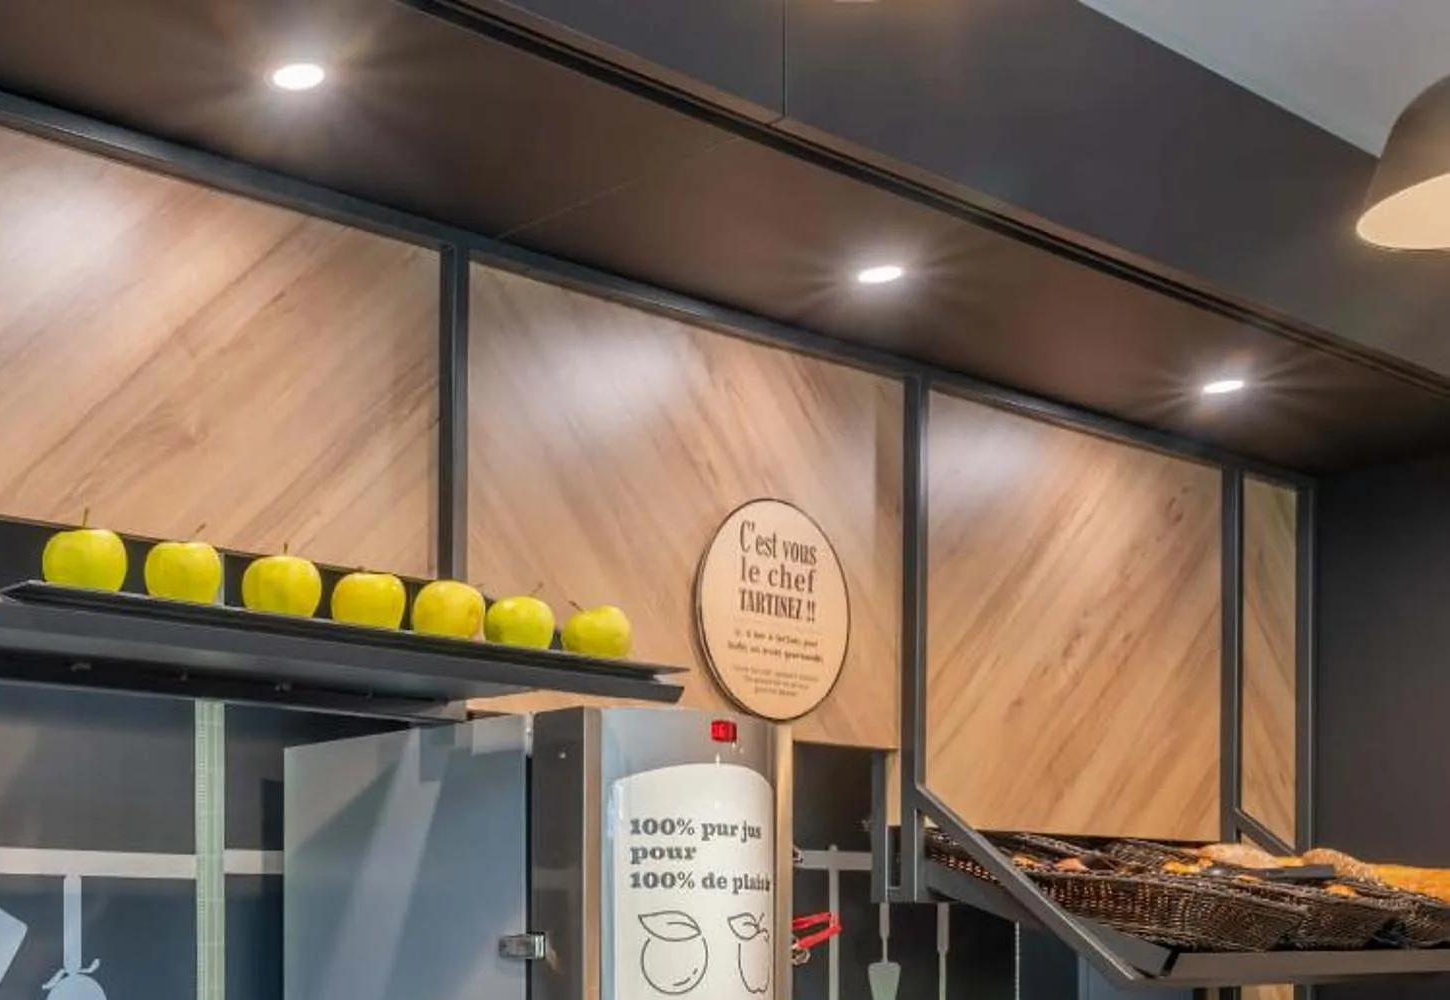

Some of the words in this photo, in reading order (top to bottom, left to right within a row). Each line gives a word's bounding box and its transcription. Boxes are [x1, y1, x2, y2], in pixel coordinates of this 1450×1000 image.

[739, 519, 777, 559] C'est
[783, 540, 817, 565] vous
[741, 556, 760, 584] le
[768, 563, 816, 594] chef
[738, 588, 802, 621] TARTINEZ
[630, 818, 695, 836] 100%
[701, 822, 739, 841] pur
[740, 820, 762, 843] jus
[630, 845, 697, 865] pour
[630, 871, 695, 889] 100%
[701, 872, 727, 890] de
